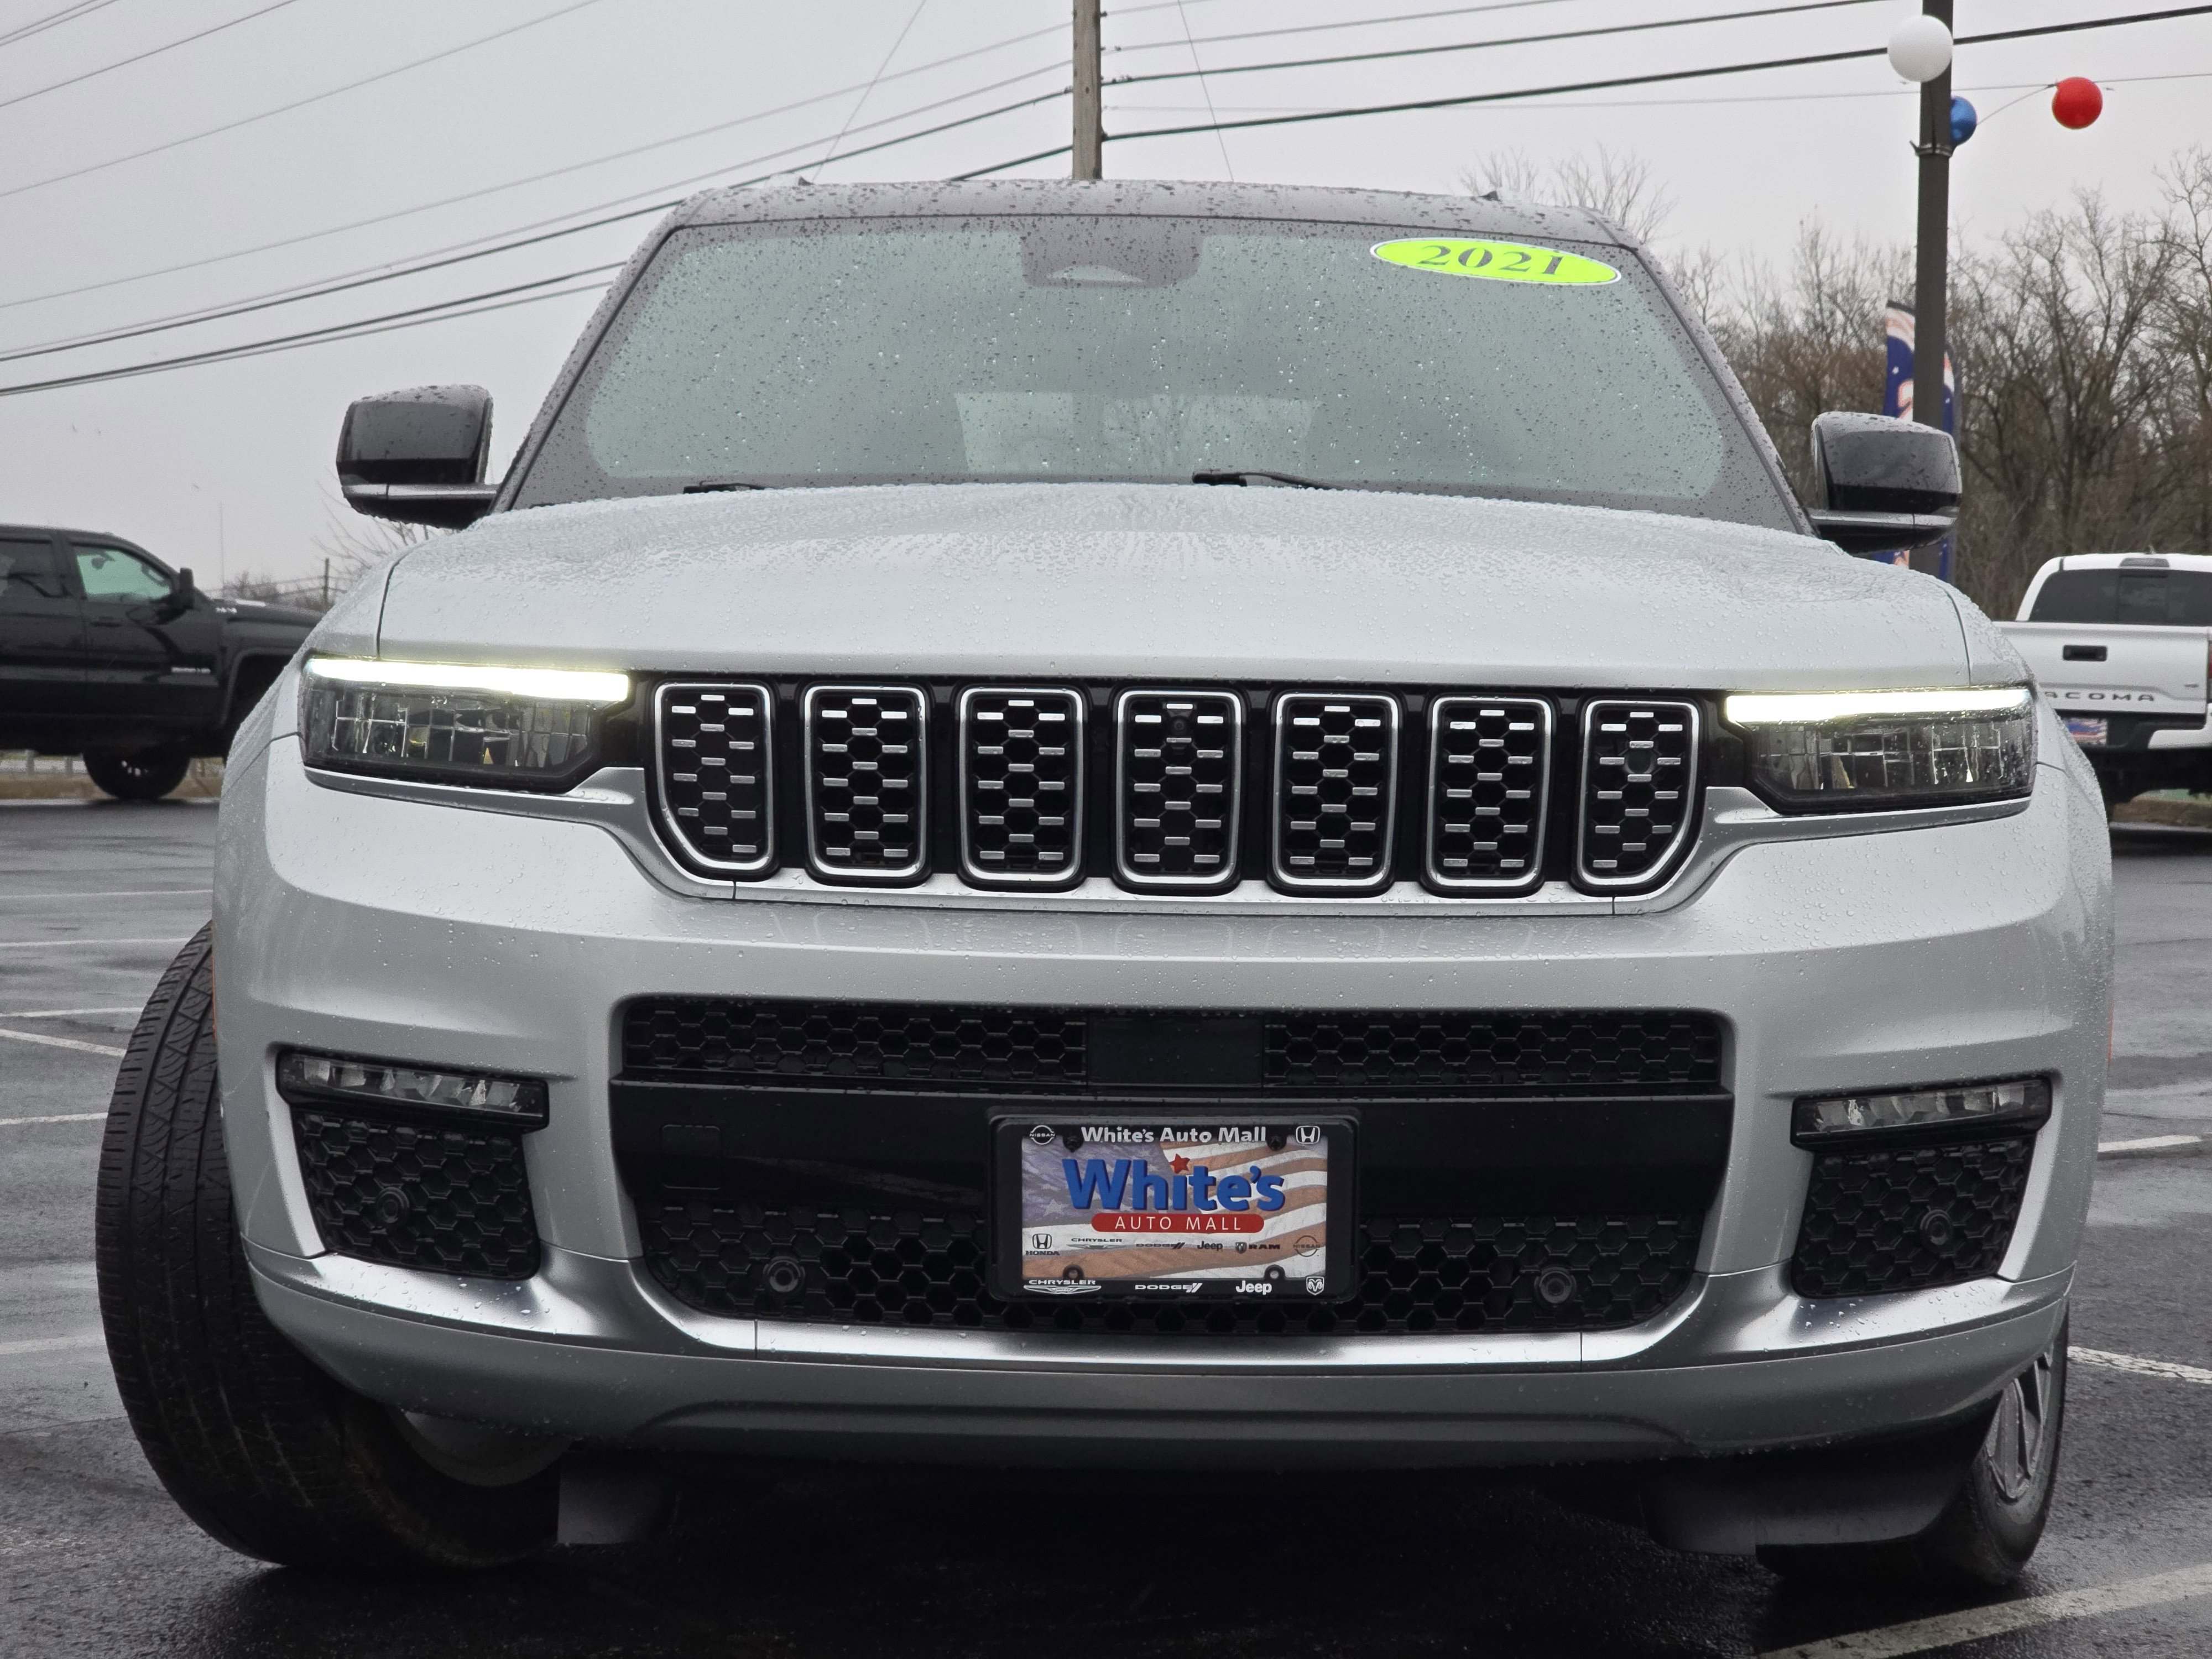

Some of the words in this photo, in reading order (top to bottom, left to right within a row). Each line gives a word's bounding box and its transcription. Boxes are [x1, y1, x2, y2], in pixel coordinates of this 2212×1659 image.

[1417, 245, 1564, 275] 2021
[2044, 691, 2155, 701] ACOMA
[1081, 1126, 1154, 1143] White's
[1160, 1127, 1212, 1143] Auto
[1218, 1126, 1266, 1142] Mall
[1062, 1154, 1286, 1211] White's
[1115, 1216, 1172, 1230] AUTO
[1186, 1217, 1241, 1230] MALL
[1197, 1241, 1223, 1251] Jeep
[1235, 1280, 1272, 1295] Jeep
